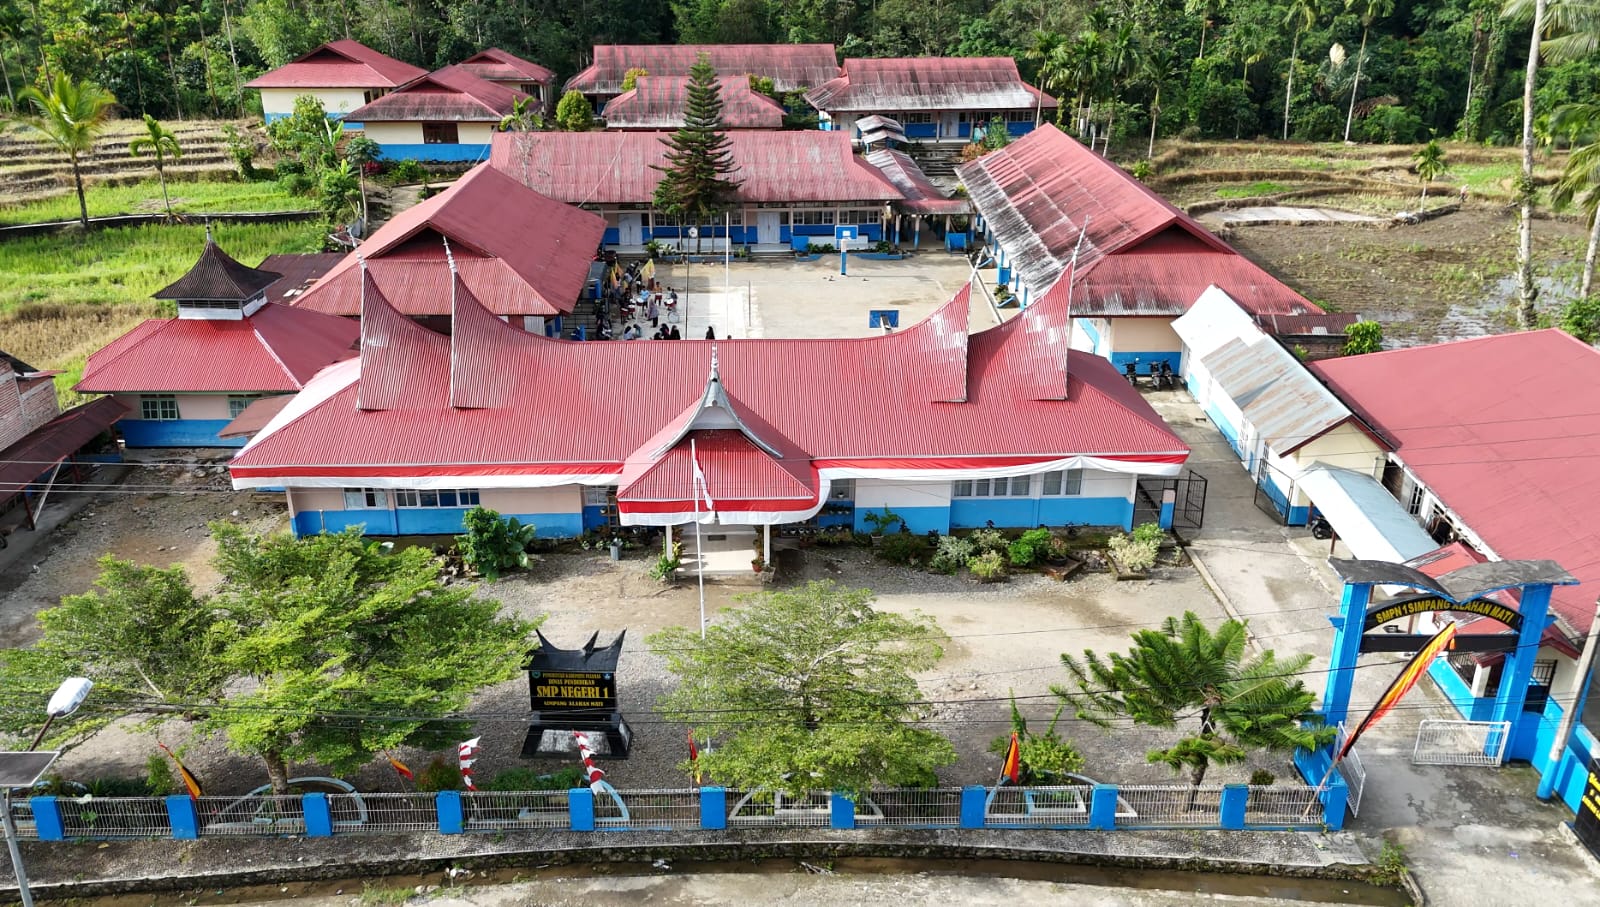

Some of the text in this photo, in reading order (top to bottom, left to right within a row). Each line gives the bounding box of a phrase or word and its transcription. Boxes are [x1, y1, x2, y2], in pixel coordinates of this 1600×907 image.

[1376, 607, 1402, 624] SMPN
[1402, 605, 1409, 615] 1
[1408, 599, 1450, 613] SIMPANG
[1490, 605, 1515, 624] MATI
[536, 686, 609, 699] SMP NEGERI 1
